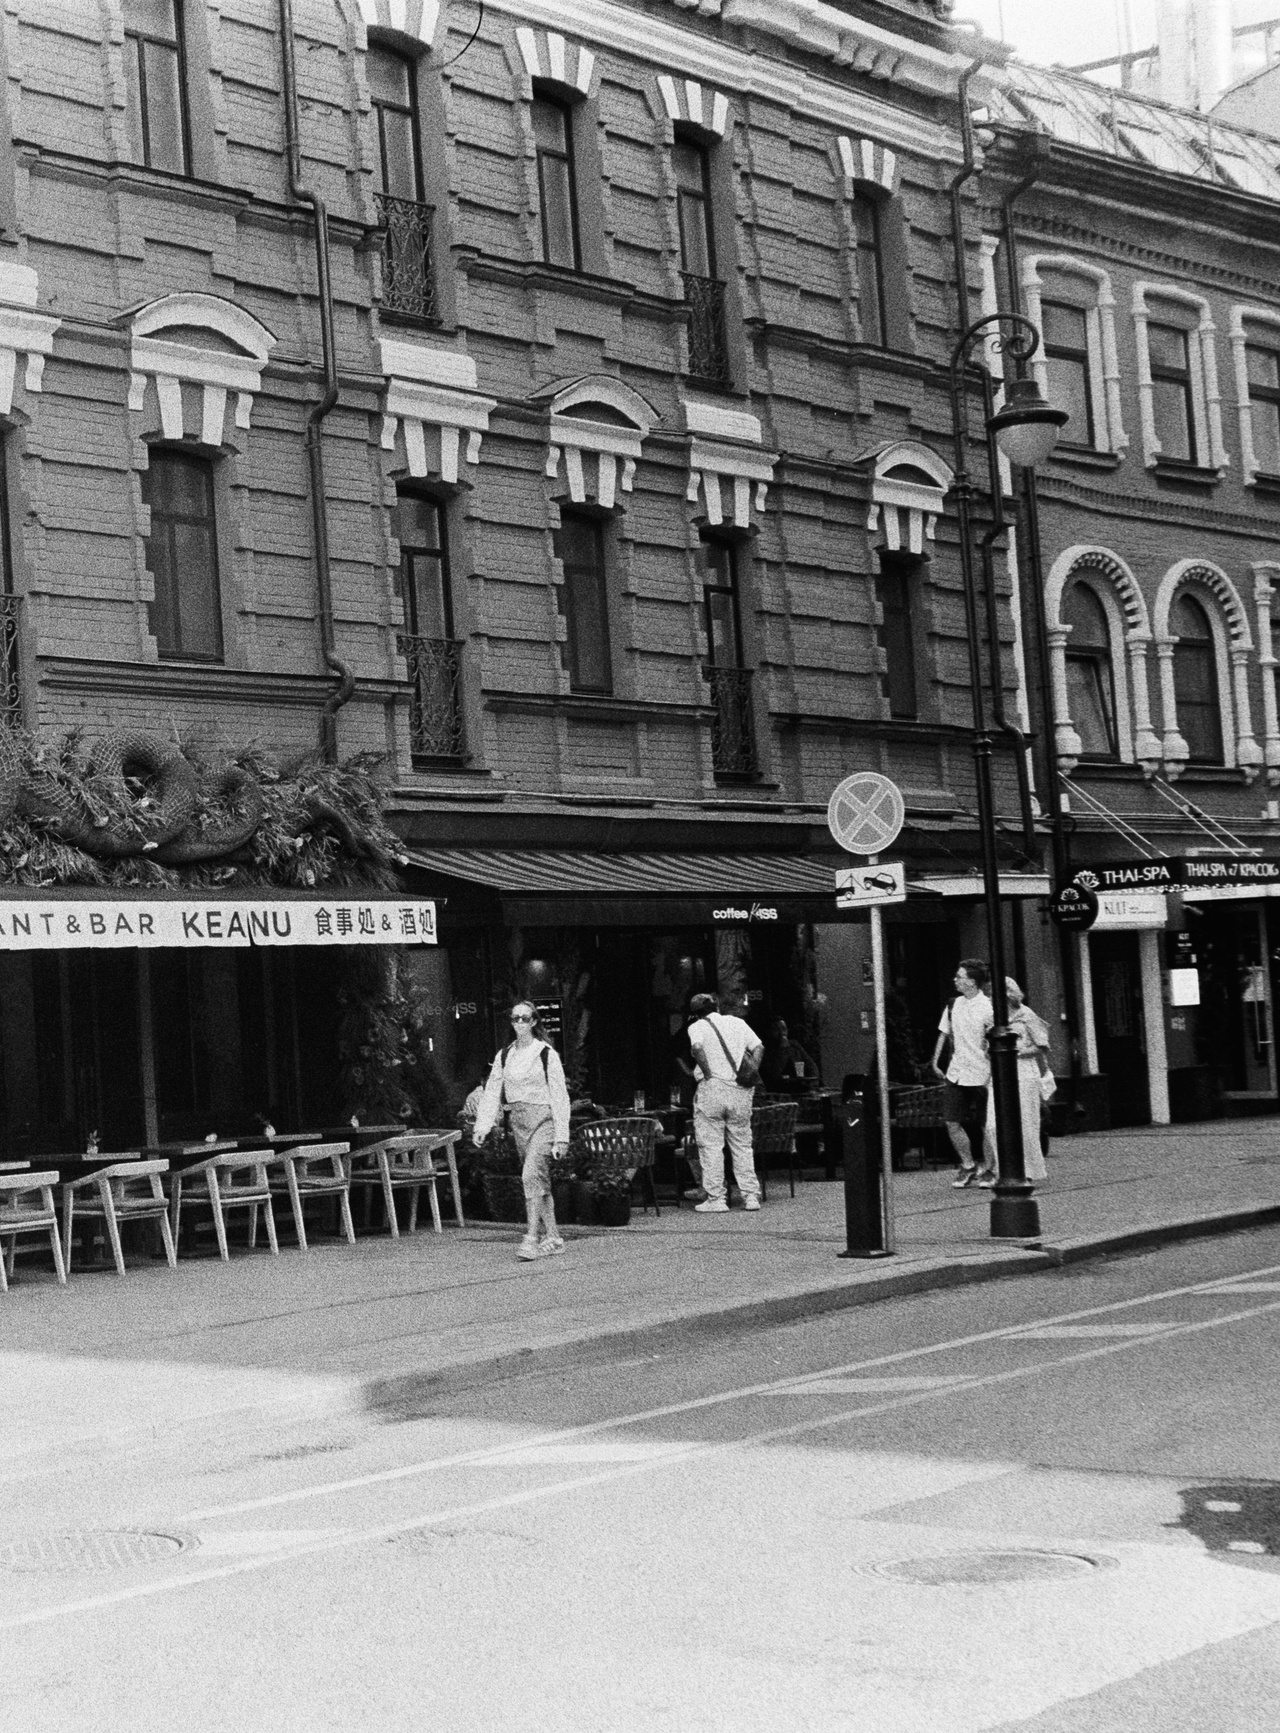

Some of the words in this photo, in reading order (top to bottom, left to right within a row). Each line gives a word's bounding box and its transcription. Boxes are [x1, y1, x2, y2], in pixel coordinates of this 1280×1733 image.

[1102, 866, 1171, 885] THAI-SPA
[1185, 863, 1227, 877] THAI-SPA
[713, 907, 748, 919] coffee
[181, 911, 293, 939] KEANU
